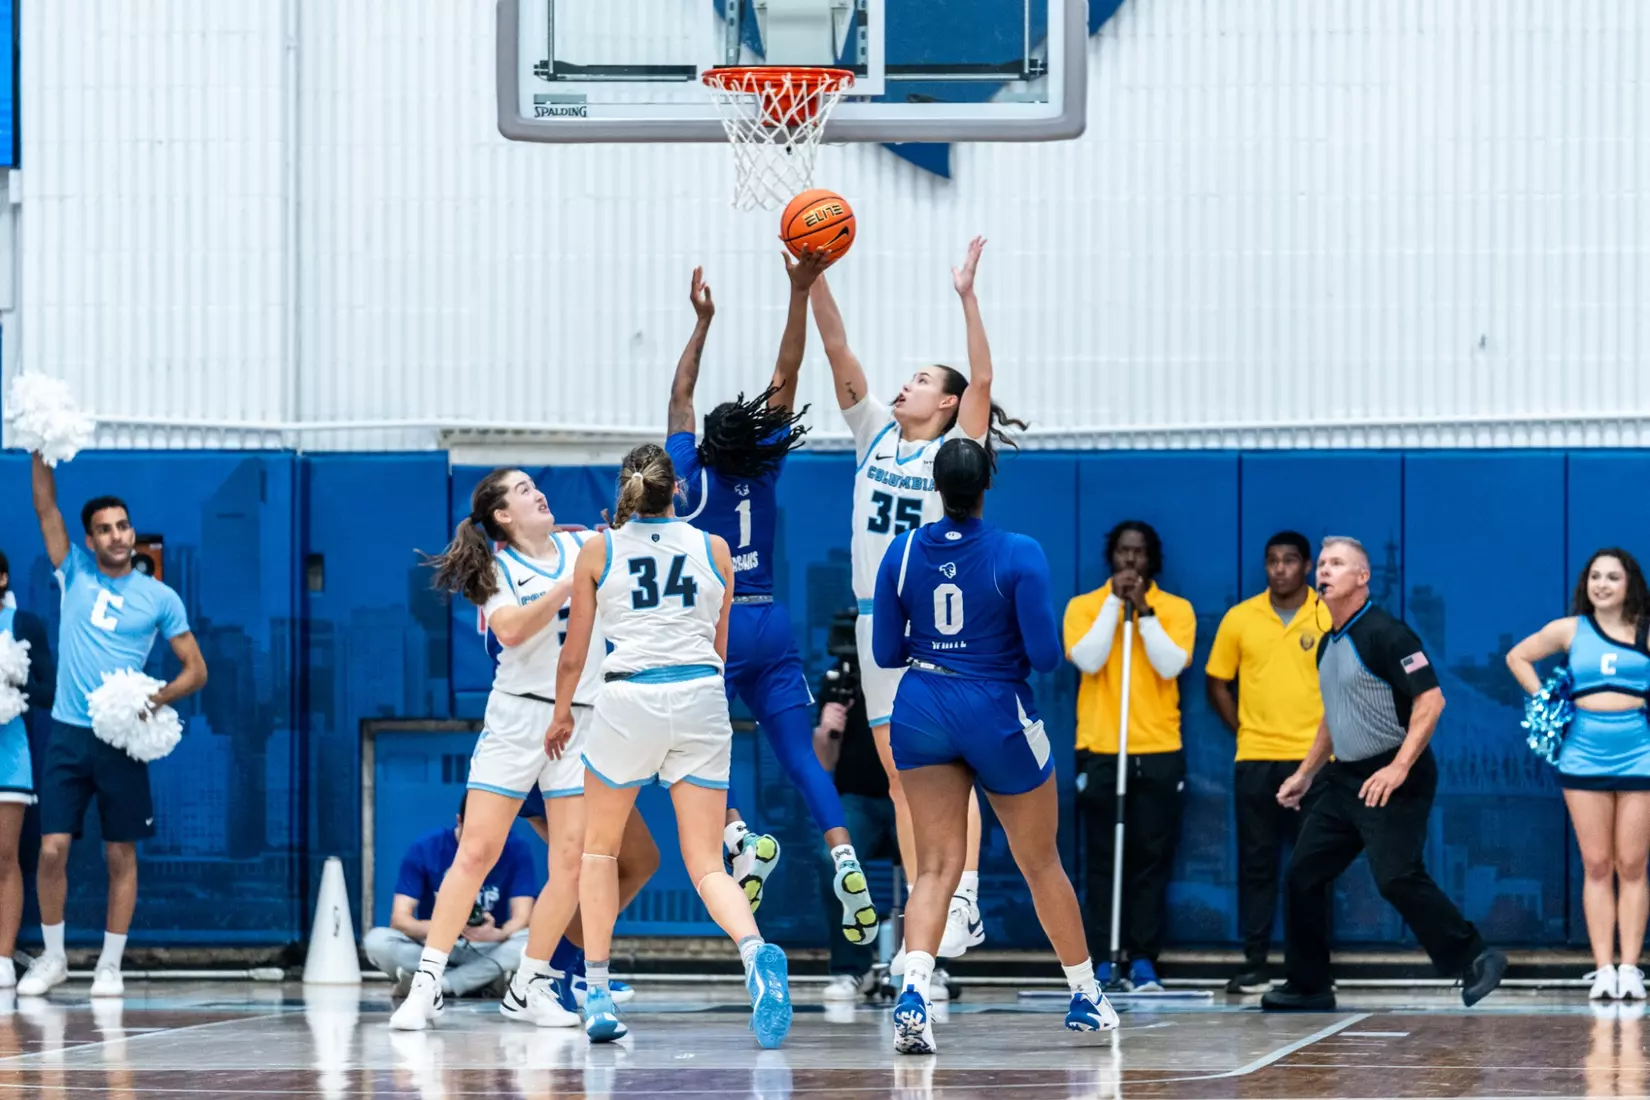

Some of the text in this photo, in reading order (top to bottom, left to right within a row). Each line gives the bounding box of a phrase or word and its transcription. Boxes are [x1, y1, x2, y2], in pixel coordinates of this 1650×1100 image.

[534, 105, 587, 117] SPALDING
[804, 204, 843, 227] ELITE
[735, 499, 751, 549] 1
[867, 489, 923, 536] 35
[627, 552, 698, 610] 34
[91, 589, 125, 631] C
[933, 583, 964, 635] 0
[1601, 653, 1617, 676] C
